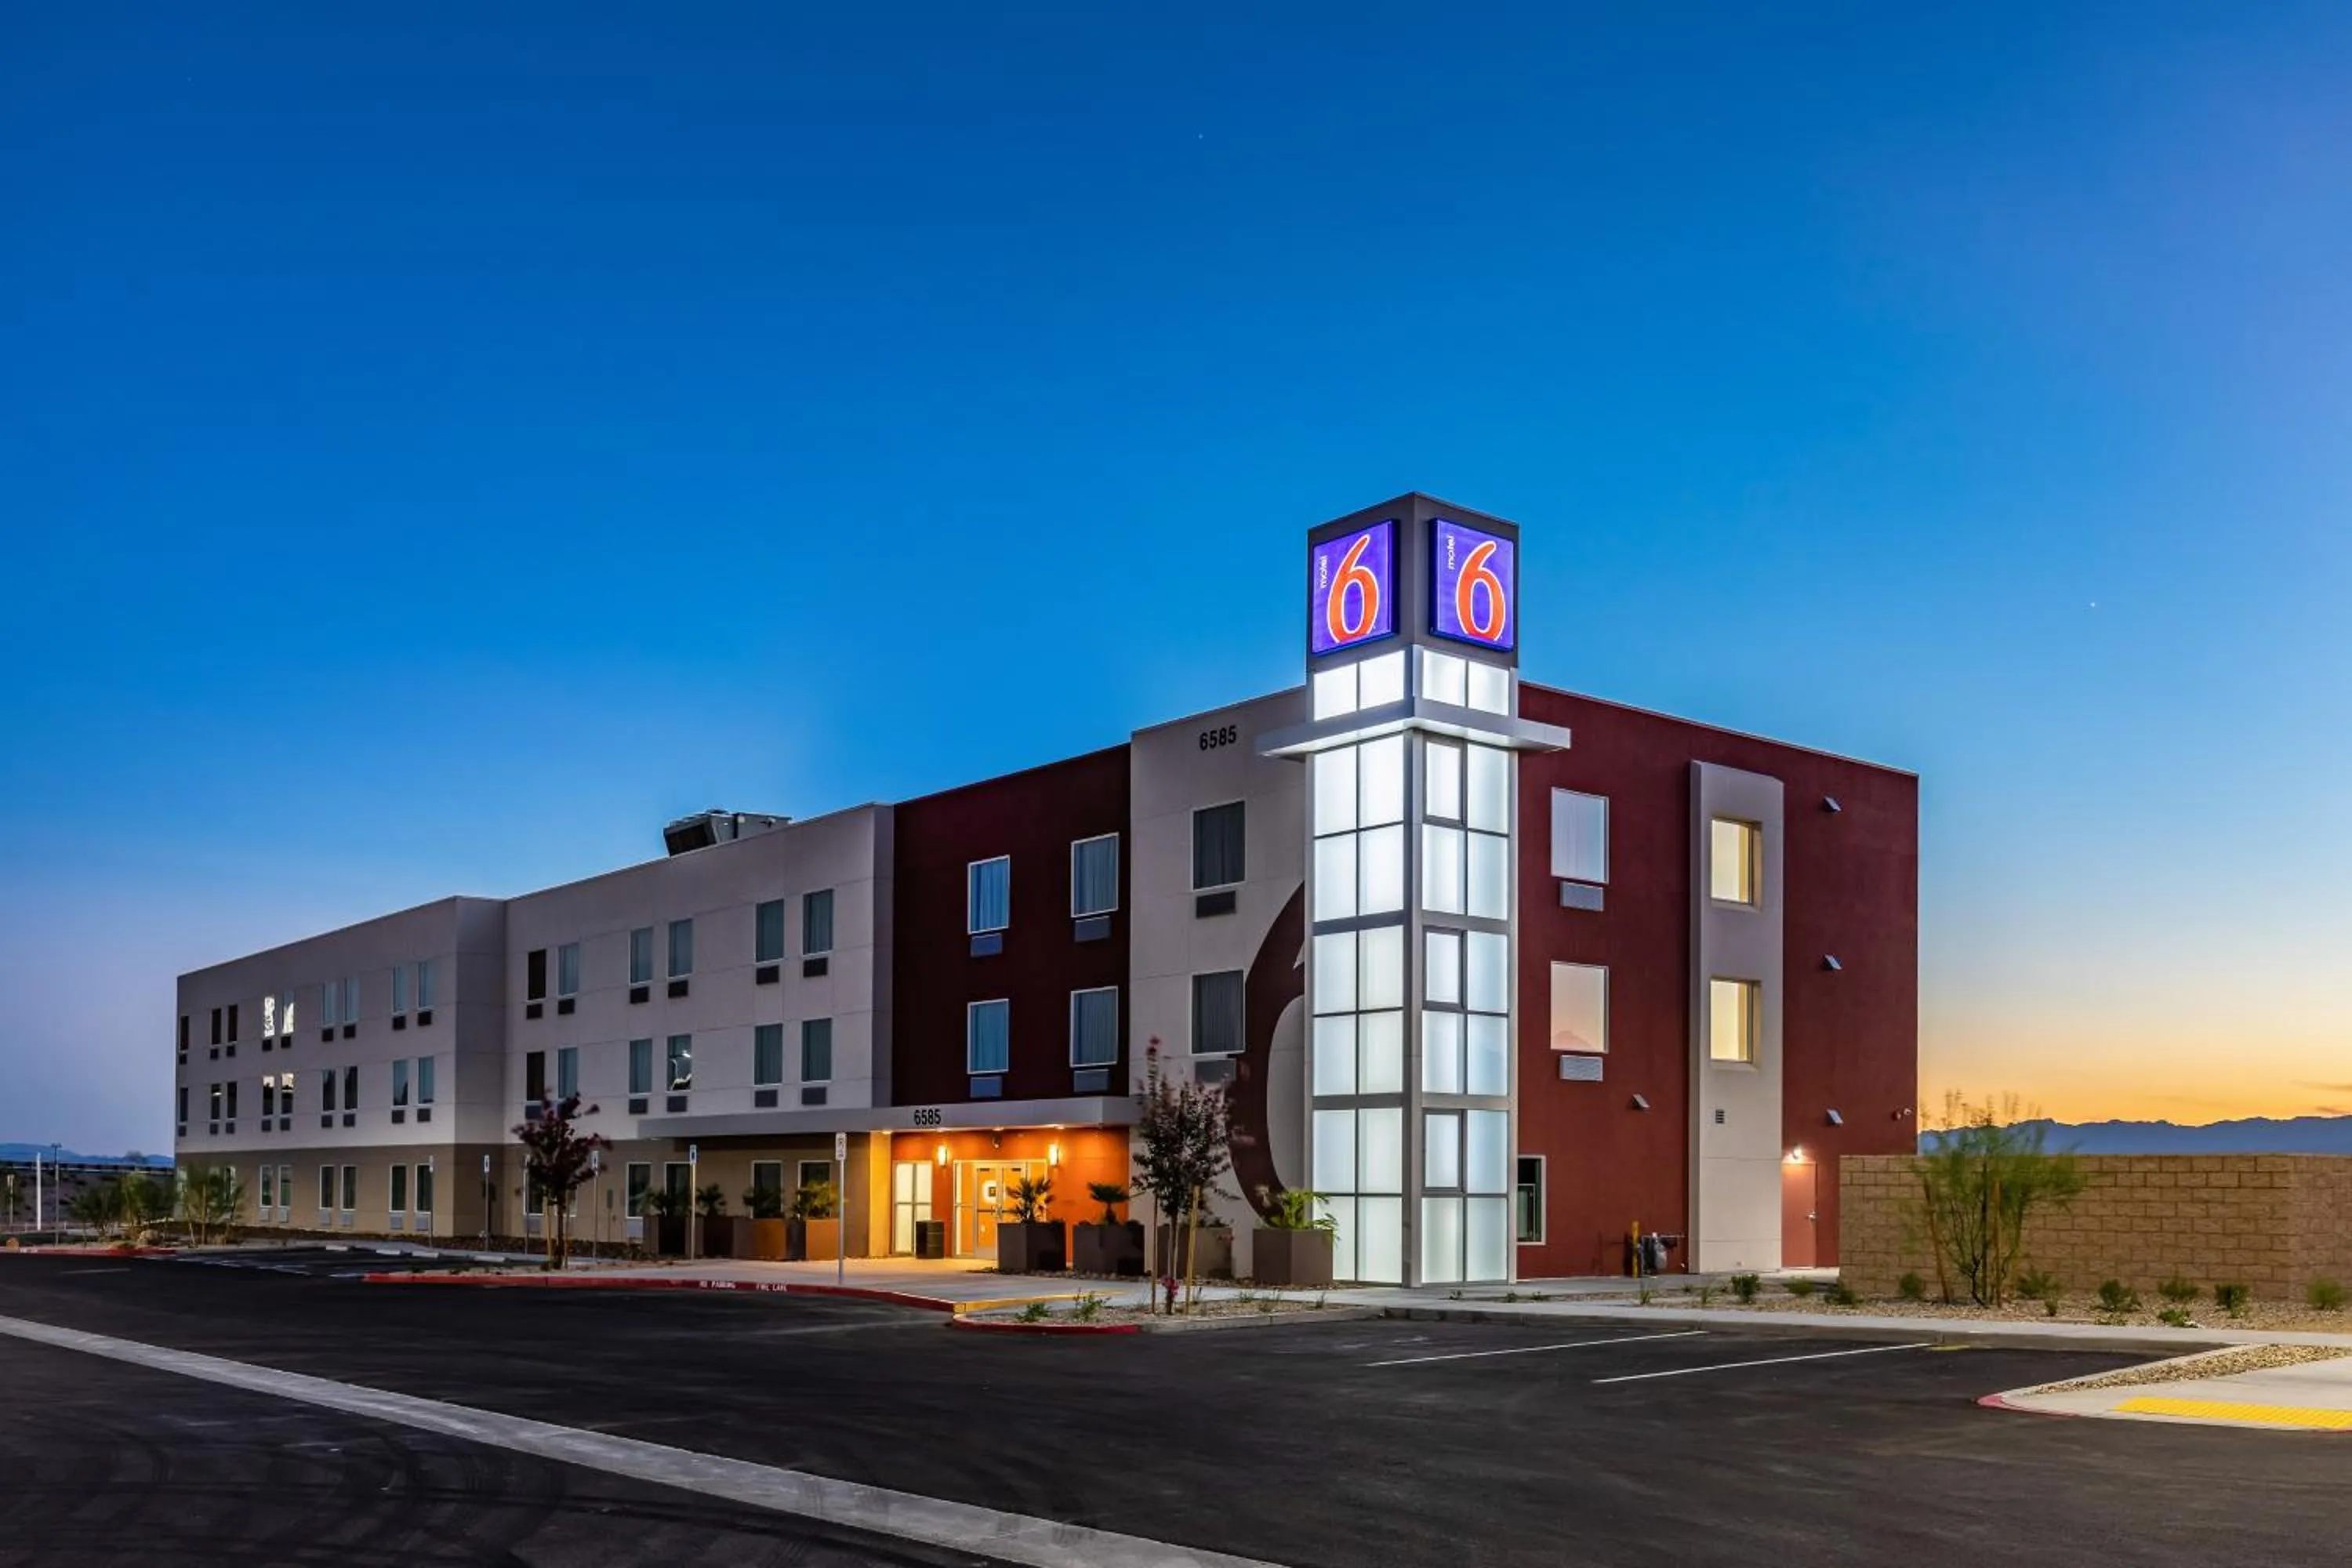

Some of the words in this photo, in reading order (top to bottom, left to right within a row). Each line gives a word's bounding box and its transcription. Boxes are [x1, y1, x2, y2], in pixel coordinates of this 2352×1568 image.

[1327, 534, 1379, 643] 6
[1455, 540, 1506, 641] 6
[1200, 724, 1236, 751] 6585
[914, 1109, 942, 1125] 6585
